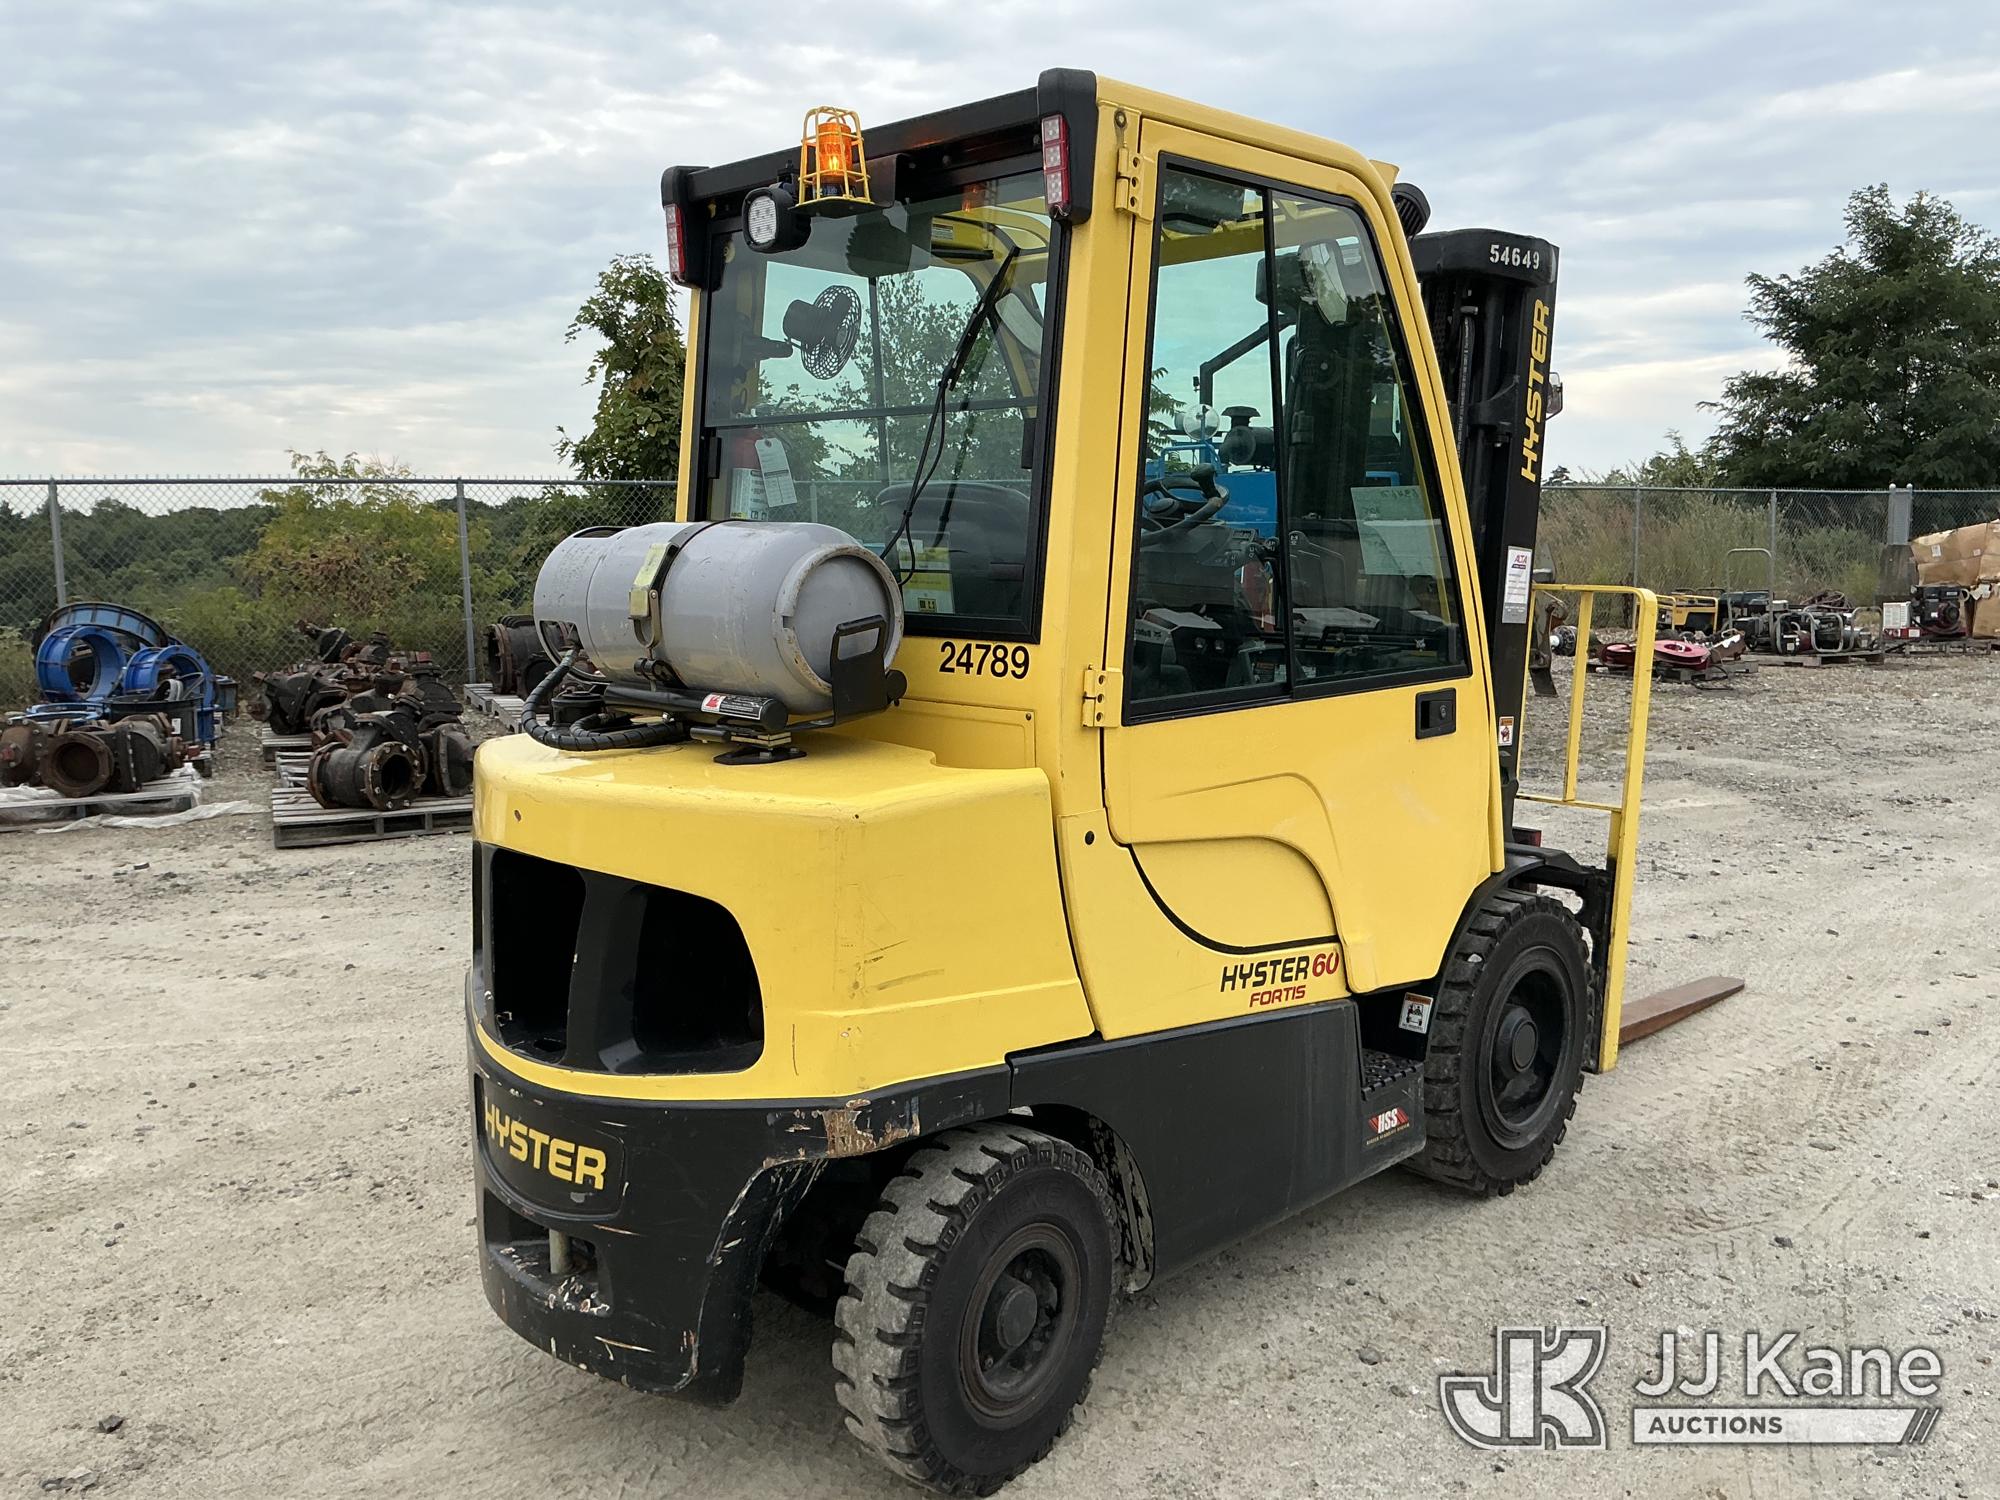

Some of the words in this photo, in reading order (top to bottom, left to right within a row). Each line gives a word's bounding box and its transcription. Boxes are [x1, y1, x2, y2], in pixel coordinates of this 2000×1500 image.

[1490, 245, 1540, 270] 54649
[1521, 299, 1550, 483] HYSTER
[939, 640, 1030, 680] 24789
[1220, 955, 1310, 992] HYSTER
[1312, 952, 1340, 977] 60
[1249, 985, 1306, 1008] FORTIS
[1377, 1108, 1398, 1134] HSS
[485, 1096, 607, 1190] HYSTER
